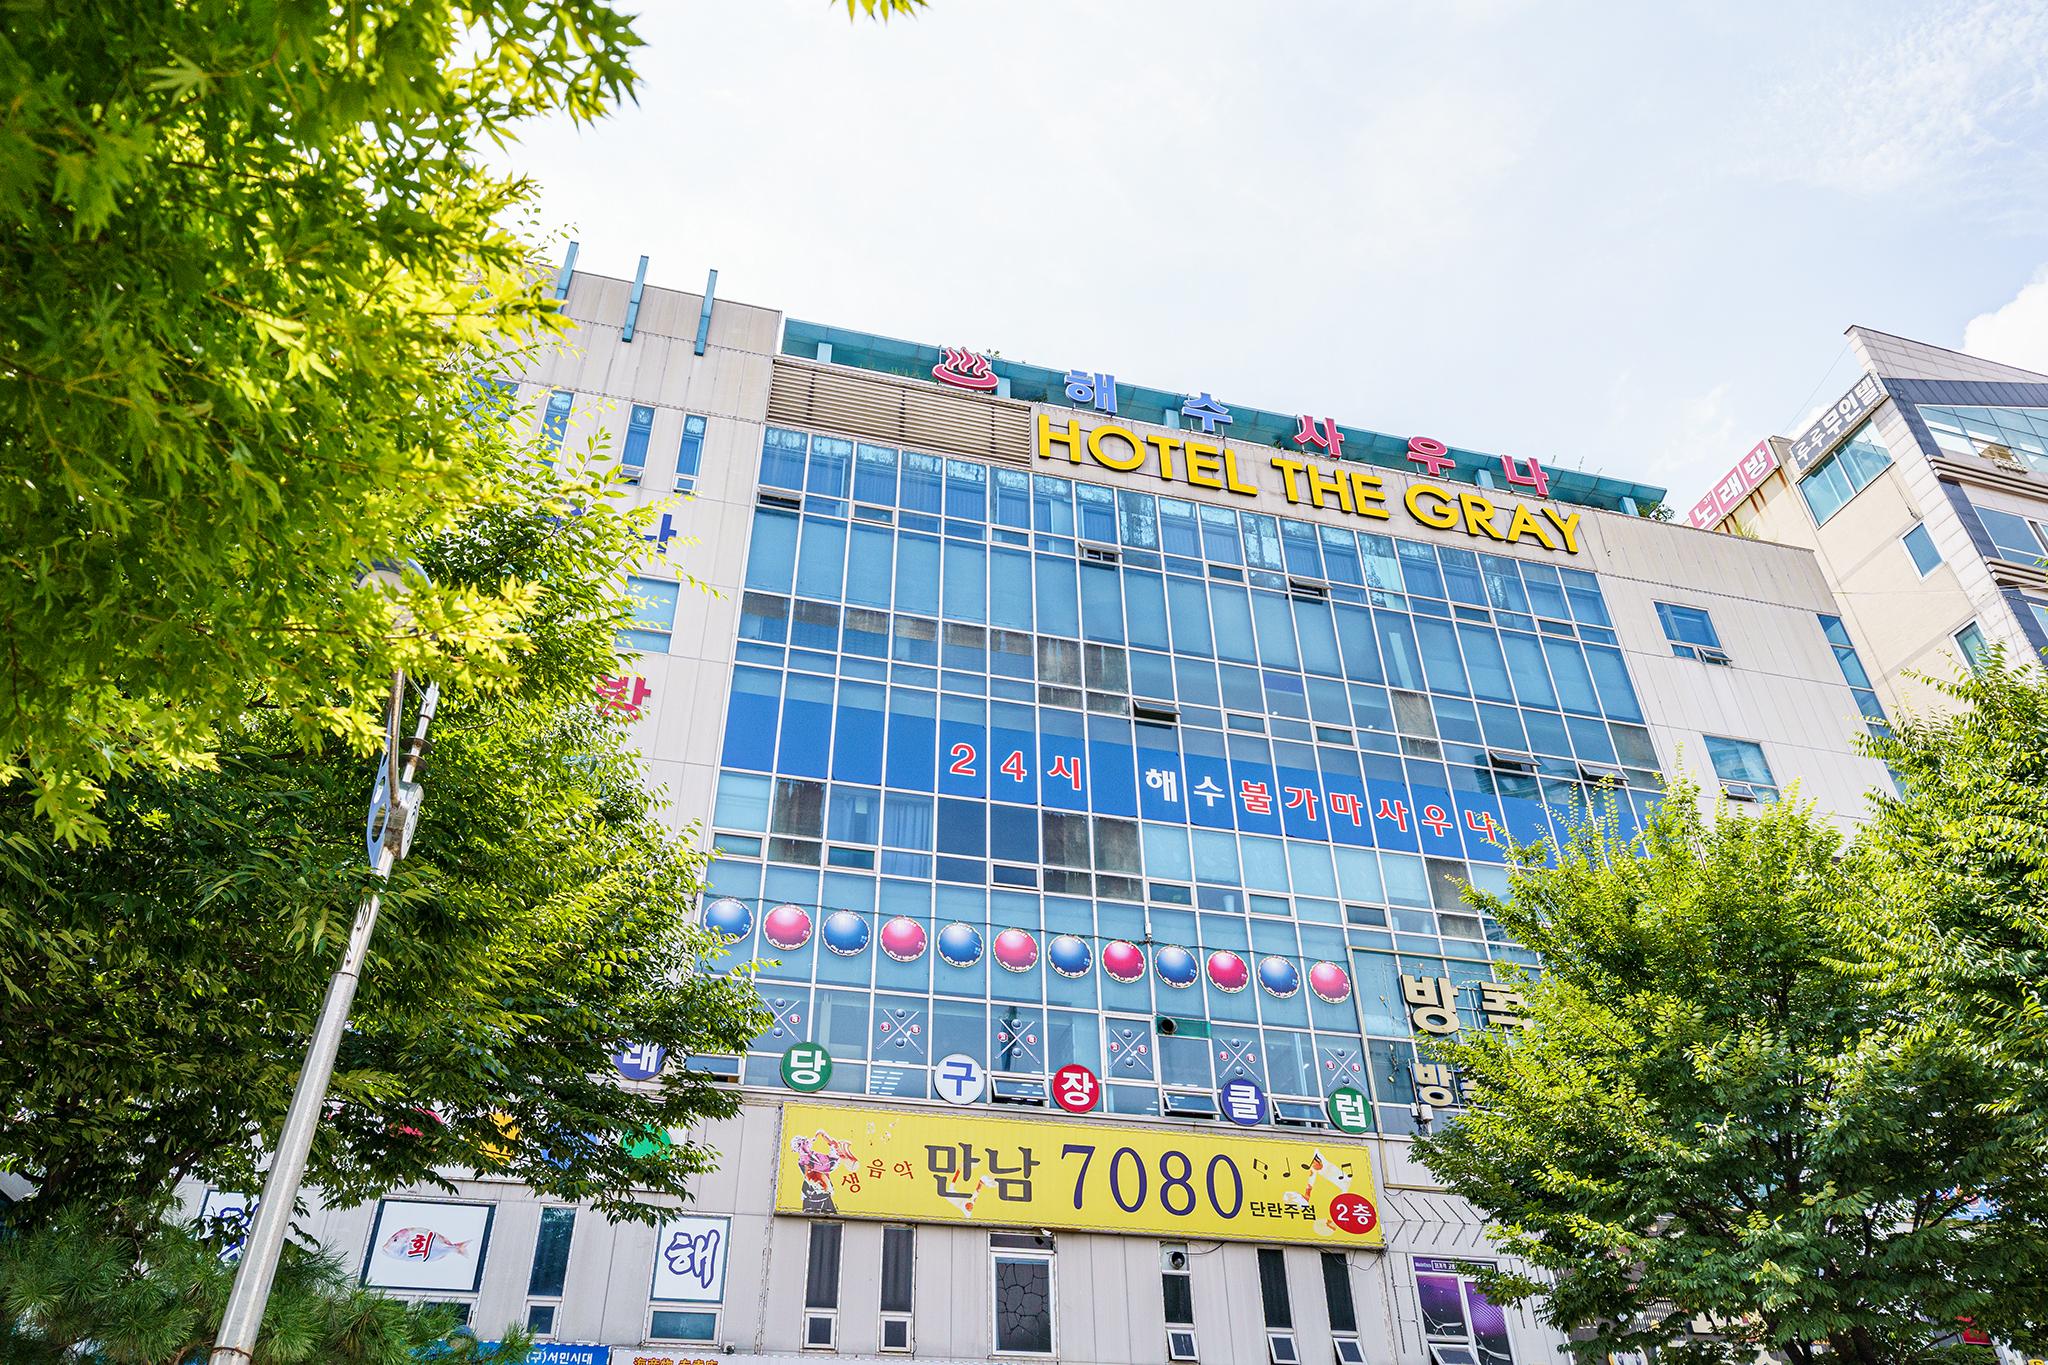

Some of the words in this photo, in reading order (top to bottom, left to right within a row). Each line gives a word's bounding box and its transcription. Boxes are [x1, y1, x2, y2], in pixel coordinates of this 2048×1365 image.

[1037, 414, 1259, 496] HOTEL
[1271, 457, 1390, 521] THE
[1405, 484, 1582, 555] GRAY
[1694, 449, 1767, 530] 노래방
[949, 742, 1083, 793] 24시
[924, 1142, 1041, 1203] 만남
[1061, 1143, 1244, 1220] 7080
[1250, 1201, 1317, 1221] 단란주점
[1335, 1203, 1373, 1226] 2층
[407, 1231, 437, 1262] 회
